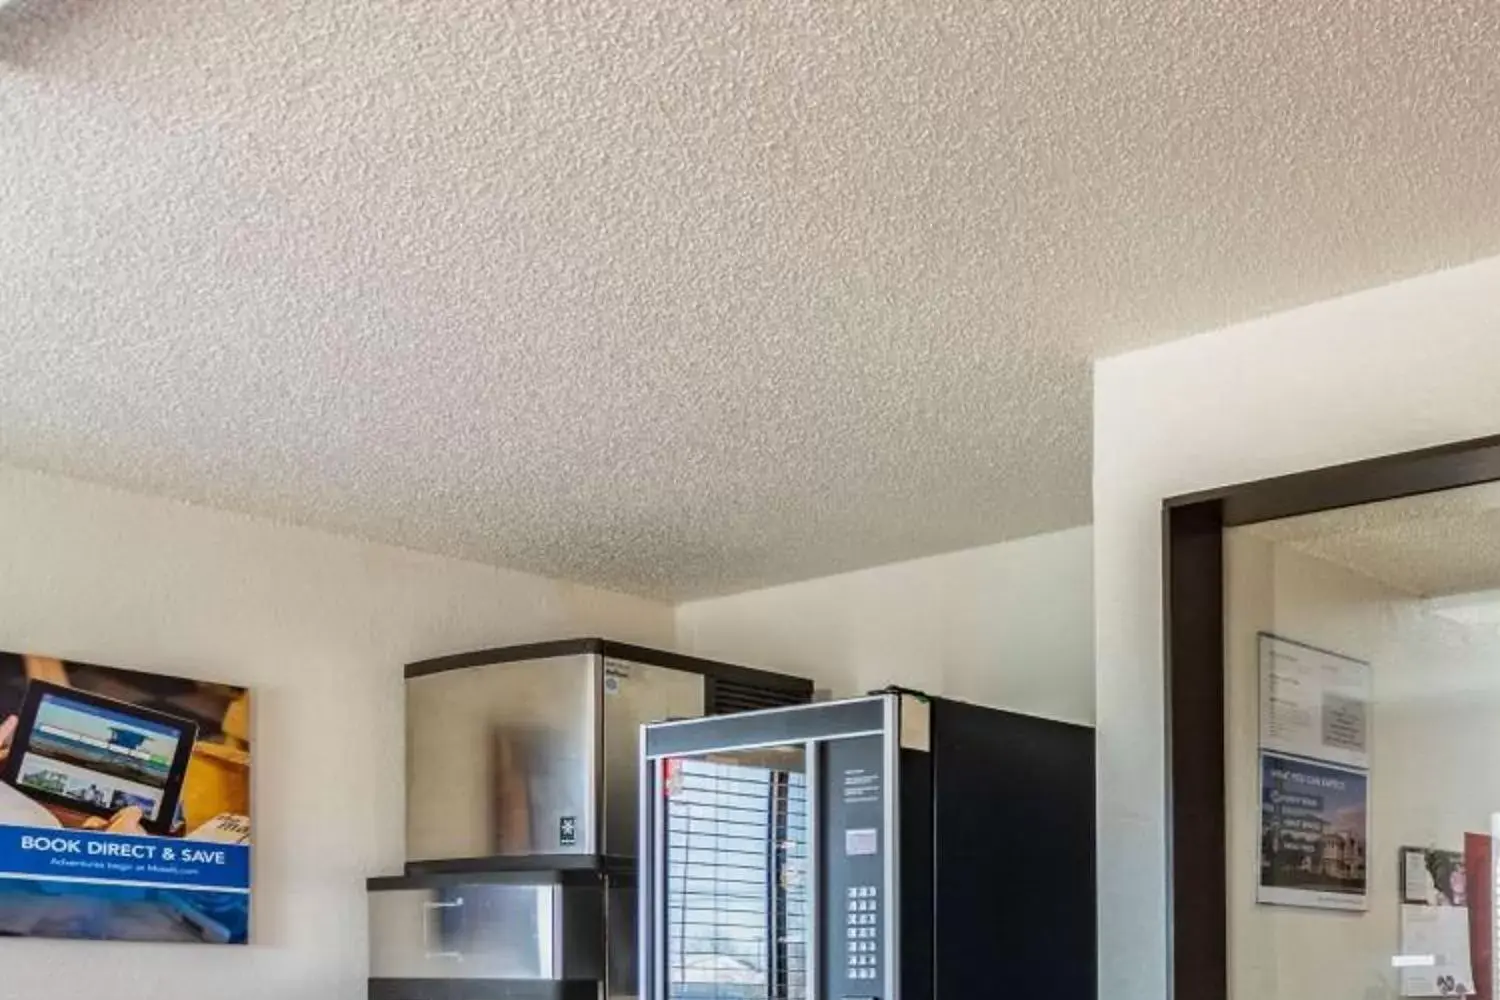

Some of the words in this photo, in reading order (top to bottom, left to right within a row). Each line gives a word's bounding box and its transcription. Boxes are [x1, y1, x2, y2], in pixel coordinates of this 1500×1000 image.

[21, 835, 81, 853] BOOK
[88, 841, 154, 859] DIRECT
[161, 847, 175, 861] &
[181, 848, 225, 865] SAVE
